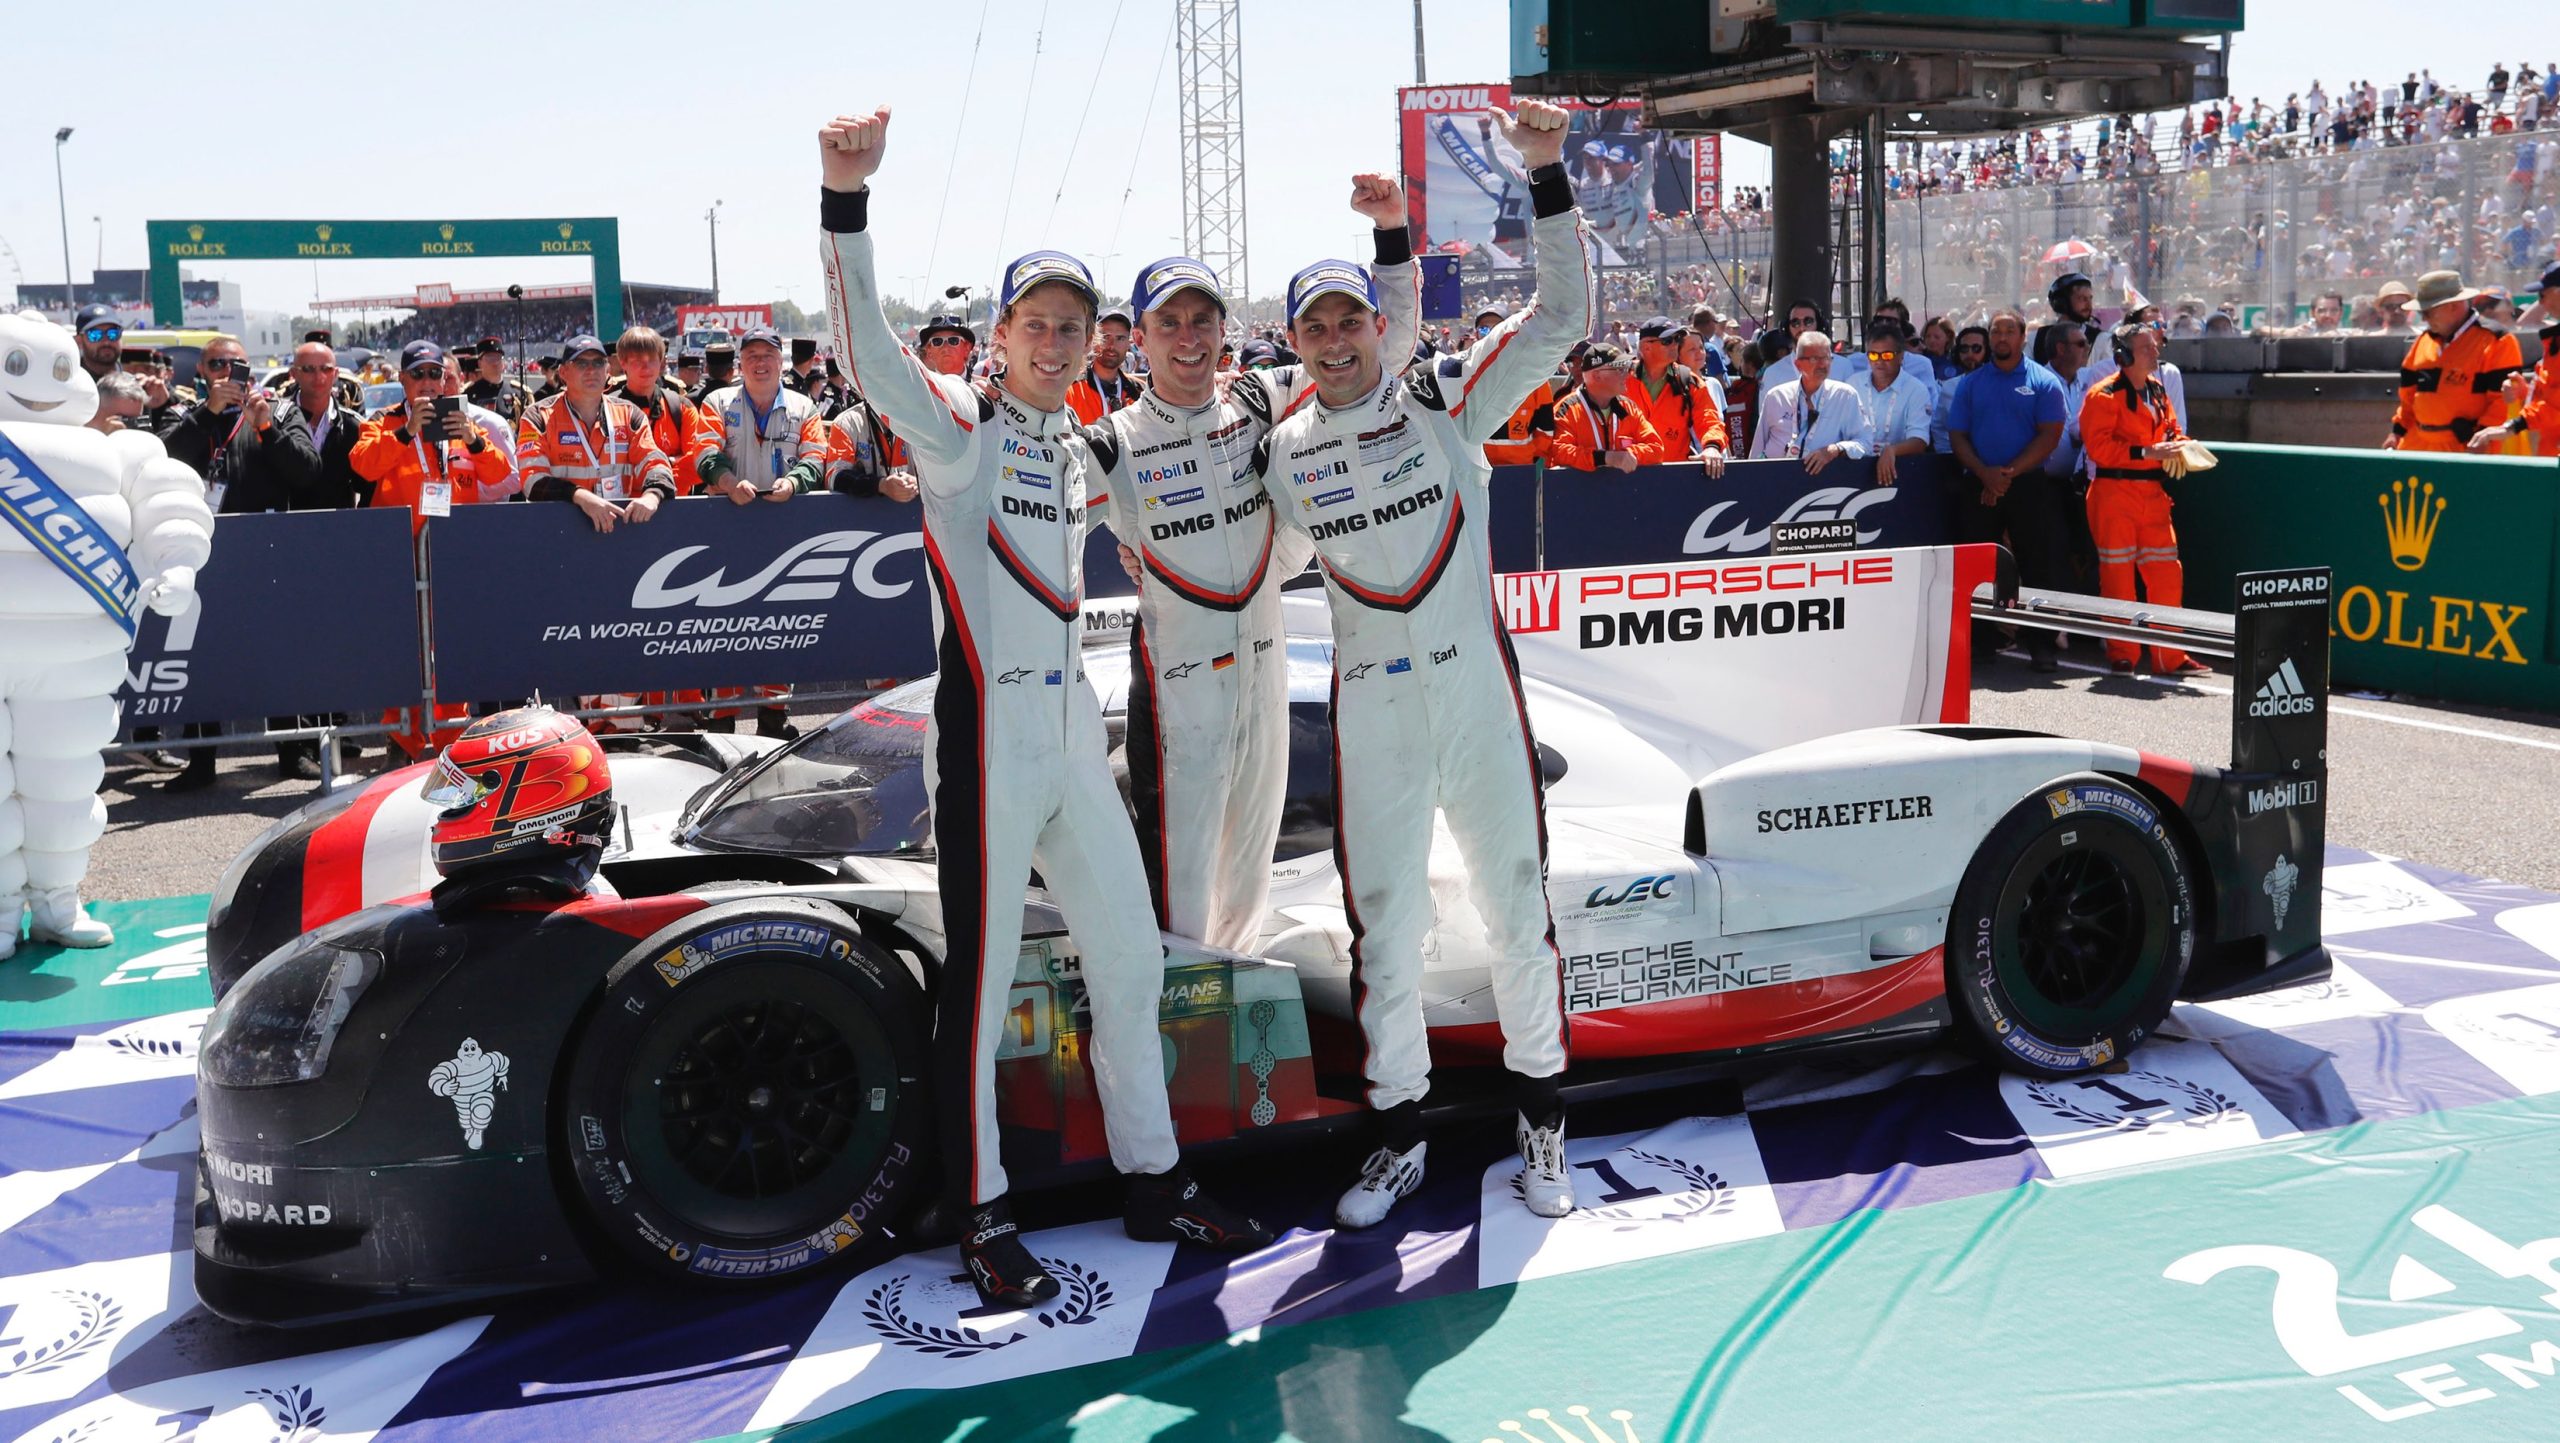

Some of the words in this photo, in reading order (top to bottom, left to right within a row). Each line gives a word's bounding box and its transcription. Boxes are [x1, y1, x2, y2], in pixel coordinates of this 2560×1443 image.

[1403, 90, 1493, 110] MOTUL
[168, 243, 226, 255] ROLEX
[298, 243, 352, 255] ROLEX
[422, 242, 474, 254] ROLEX
[541, 240, 592, 252] ROLEX
[418, 287, 451, 304] MOTUL
[683, 311, 769, 331] MOTUL
[827, 258, 847, 369] PORSCHE
[1133, 445, 1160, 458] DMG
[1161, 438, 1192, 452] MORI
[1291, 448, 1316, 460] DMG
[1316, 439, 1343, 454] MORI
[1137, 463, 1182, 485] Mobil
[1293, 463, 1332, 486] Mobil
[1382, 453, 1425, 483] WEC
[1166, 489, 1203, 503] MICHELIN
[1316, 490, 1354, 504] MICHELIN
[1002, 495, 1057, 523] DMG
[1309, 513, 1368, 542] DMG
[1372, 484, 1444, 526] MORI
[1150, 513, 1216, 541] DMG
[1776, 525, 1854, 541] CHOPARD
[1825, 541, 1853, 549] PARTNER
[631, 530, 924, 609] WEC
[1580, 557, 1893, 604] PORSCHE
[2242, 576, 2329, 597] CHOPARD
[2242, 602, 2270, 611] OFFICIAL
[2270, 600, 2294, 608] TIMING
[2294, 598, 2328, 606] PARTNER
[543, 625, 582, 641] FIA
[590, 621, 673, 640] WORLD
[677, 613, 829, 636] ENDURANCE
[1085, 609, 1136, 631] Mob
[1580, 607, 1703, 650] DMG
[1714, 597, 1845, 640] MORI
[2330, 585, 2529, 666] OLEX
[642, 633, 820, 656] CHAMPIONSHIP
[1253, 637, 1274, 655] Timo
[1433, 644, 1458, 666] Earl
[125, 660, 189, 694] NS
[135, 696, 184, 716] 2017
[2249, 695, 2315, 717] adidas
[488, 727, 544, 754] KÜS
[2085, 791, 2152, 823] MICHELIN
[2248, 782, 2298, 814] Mobil
[2300, 780, 2317, 805] 1
[518, 819, 547, 832] DMG
[547, 809, 576, 824] MORI
[1757, 795, 1933, 834] SCHAEFFLER
[496, 836, 536, 850] SCHUBERTH
[1272, 867, 1302, 878] Hartley
[1585, 875, 1676, 909] WEC
[1560, 914, 1572, 922] FIA
[1573, 911, 1598, 920] WORLD
[1599, 905, 1645, 916] ENDURANCE
[1588, 912, 1642, 924] CHAMPIONSHIP
[711, 926, 824, 951] MICHELIN
[850, 950, 881, 975] MICHELIN
[1564, 963, 1792, 1011] RFORMANCE
[1012, 997, 1036, 1048] 1
[2009, 1034, 2081, 1066] MICHELIN
[2072, 1078, 2170, 1113] 1
[1571, 1158, 1663, 1204] 1
[637, 1226, 670, 1251] MICHELIN
[696, 1249, 810, 1274] MICHELIN
[2336, 1362, 2497, 1422] LE
